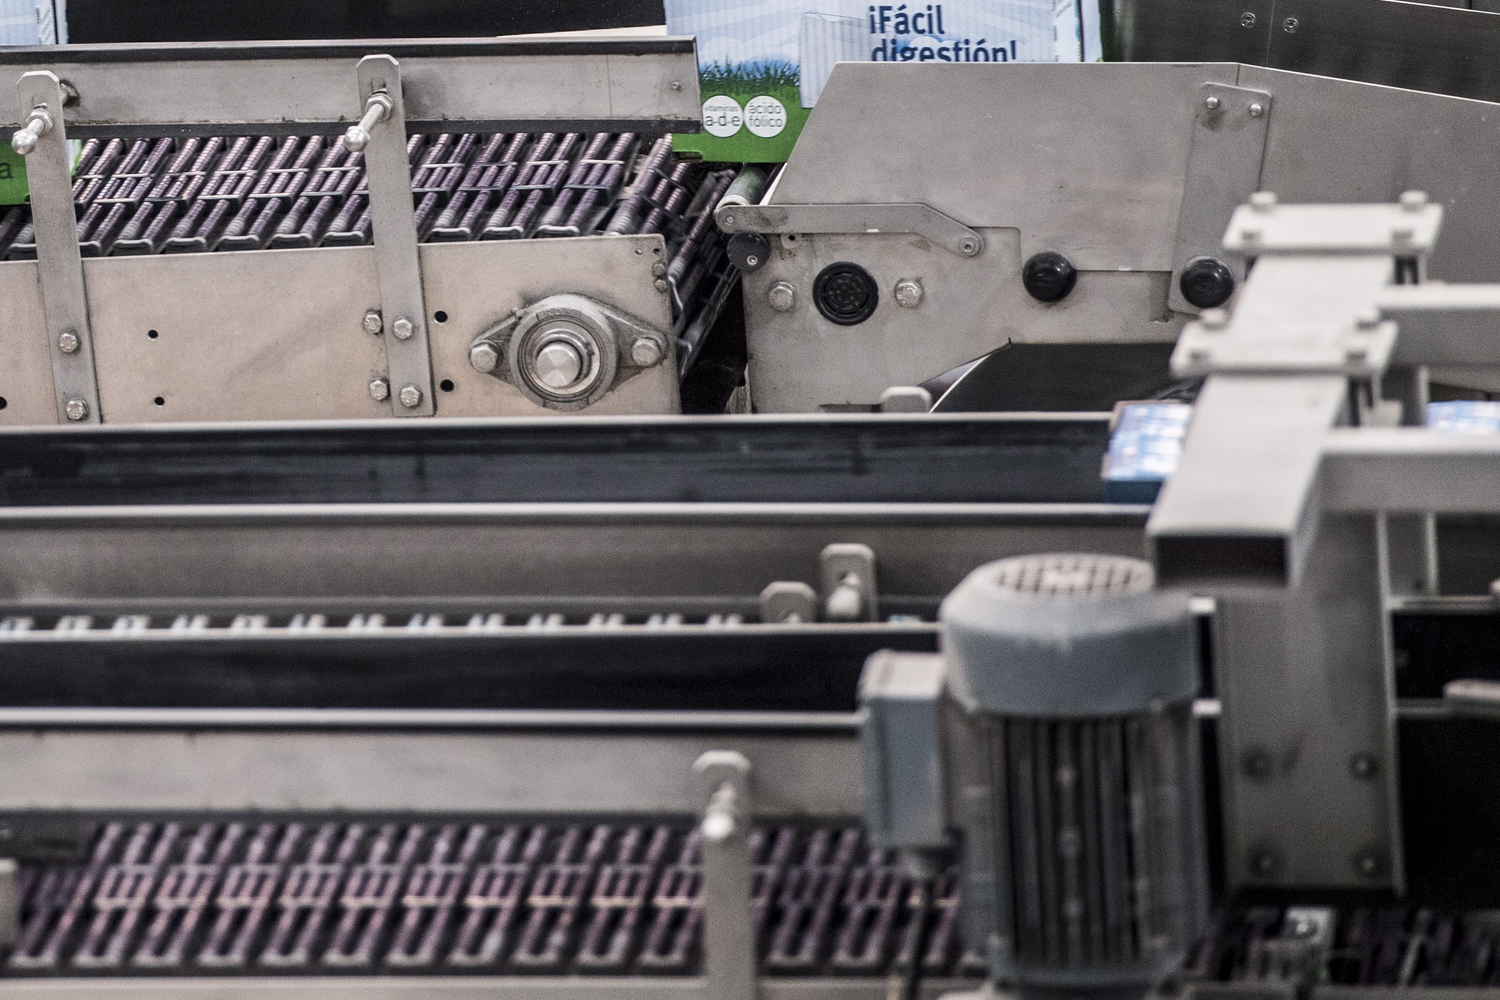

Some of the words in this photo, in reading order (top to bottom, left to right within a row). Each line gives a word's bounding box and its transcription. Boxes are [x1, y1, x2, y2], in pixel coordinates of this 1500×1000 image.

[748, 101, 782, 114] ácido
[704, 111, 741, 127] a-d-e
[748, 114, 783, 128] fólico
